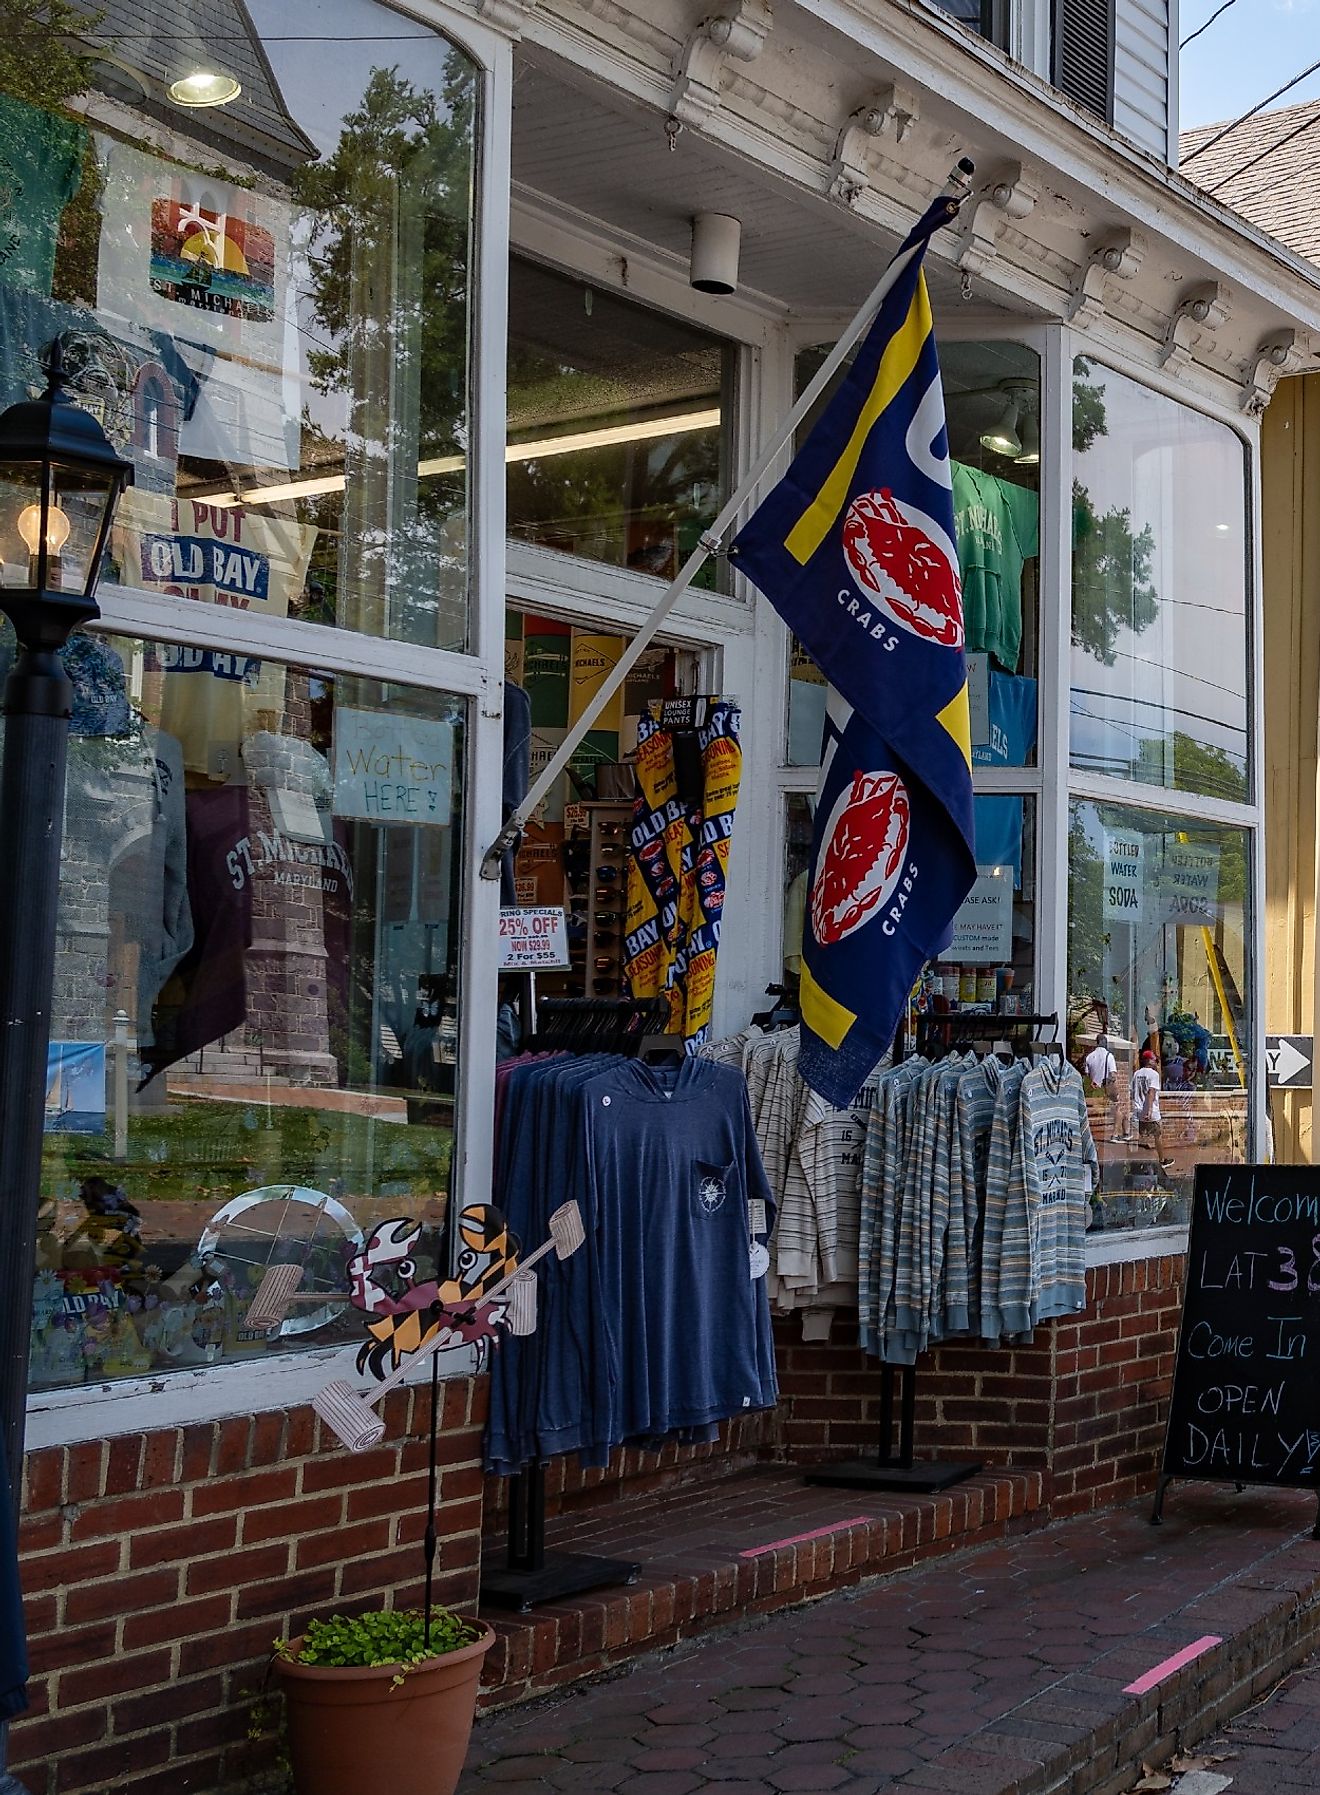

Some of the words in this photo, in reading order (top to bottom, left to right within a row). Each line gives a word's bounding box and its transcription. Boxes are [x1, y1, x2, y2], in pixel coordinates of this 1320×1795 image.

[192, 501, 246, 543] PUT
[150, 541, 205, 579] OLD
[213, 546, 260, 593] BAY
[837, 588, 901, 653] CRABS
[664, 708, 691, 717] LOUNGE
[665, 700, 692, 710] UNISEX
[663, 716, 691, 726] PANTS
[346, 744, 447, 782] Water
[631, 811, 666, 848] OLD
[1110, 861, 1138, 878] WATER
[882, 862, 919, 937] CRABS
[982, 896, 1001, 905] ASK!
[1108, 886, 1139, 909] SODA
[501, 910, 521, 918] RING
[523, 909, 562, 917] SPECIALS
[500, 918, 529, 936] 25%
[533, 917, 558, 934] OFF
[977, 923, 996, 931] HAVE
[511, 941, 528, 952] NOW
[529, 940, 550, 951] $29.99
[625, 919, 660, 958] BAY
[507, 953, 514, 961] 2
[537, 952, 556, 960] $55
[1201, 1250, 1268, 1290] LAT
[63, 1295, 88, 1315] LD
[1188, 1320, 1255, 1359] Come
[1266, 1316, 1307, 1360] In
[1198, 1380, 1286, 1416] OPEN
